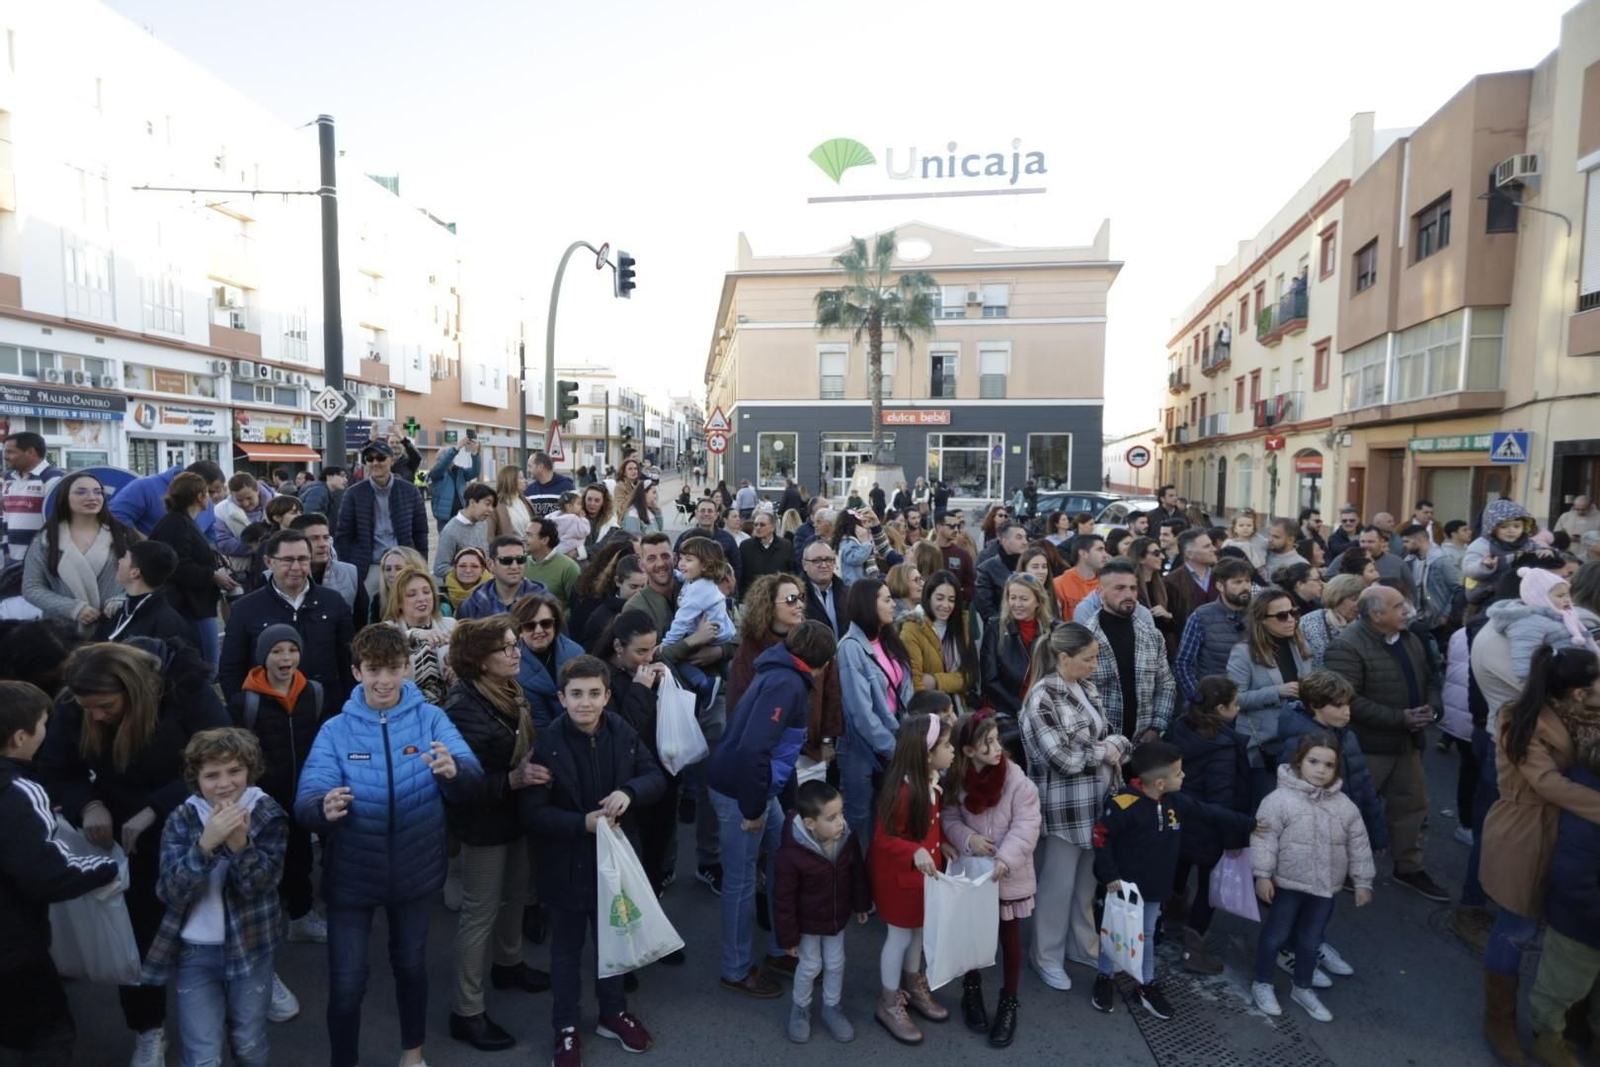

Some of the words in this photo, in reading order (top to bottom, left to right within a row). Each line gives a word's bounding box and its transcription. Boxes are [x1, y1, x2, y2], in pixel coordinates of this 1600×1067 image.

[886, 138, 1048, 185] Unicaja
[37, 391, 71, 403] MALENI
[72, 395, 110, 407] CANTERO
[322, 399, 336, 409] 15
[887, 411, 916, 422] dulce
[1168, 808, 1177, 827] 3
